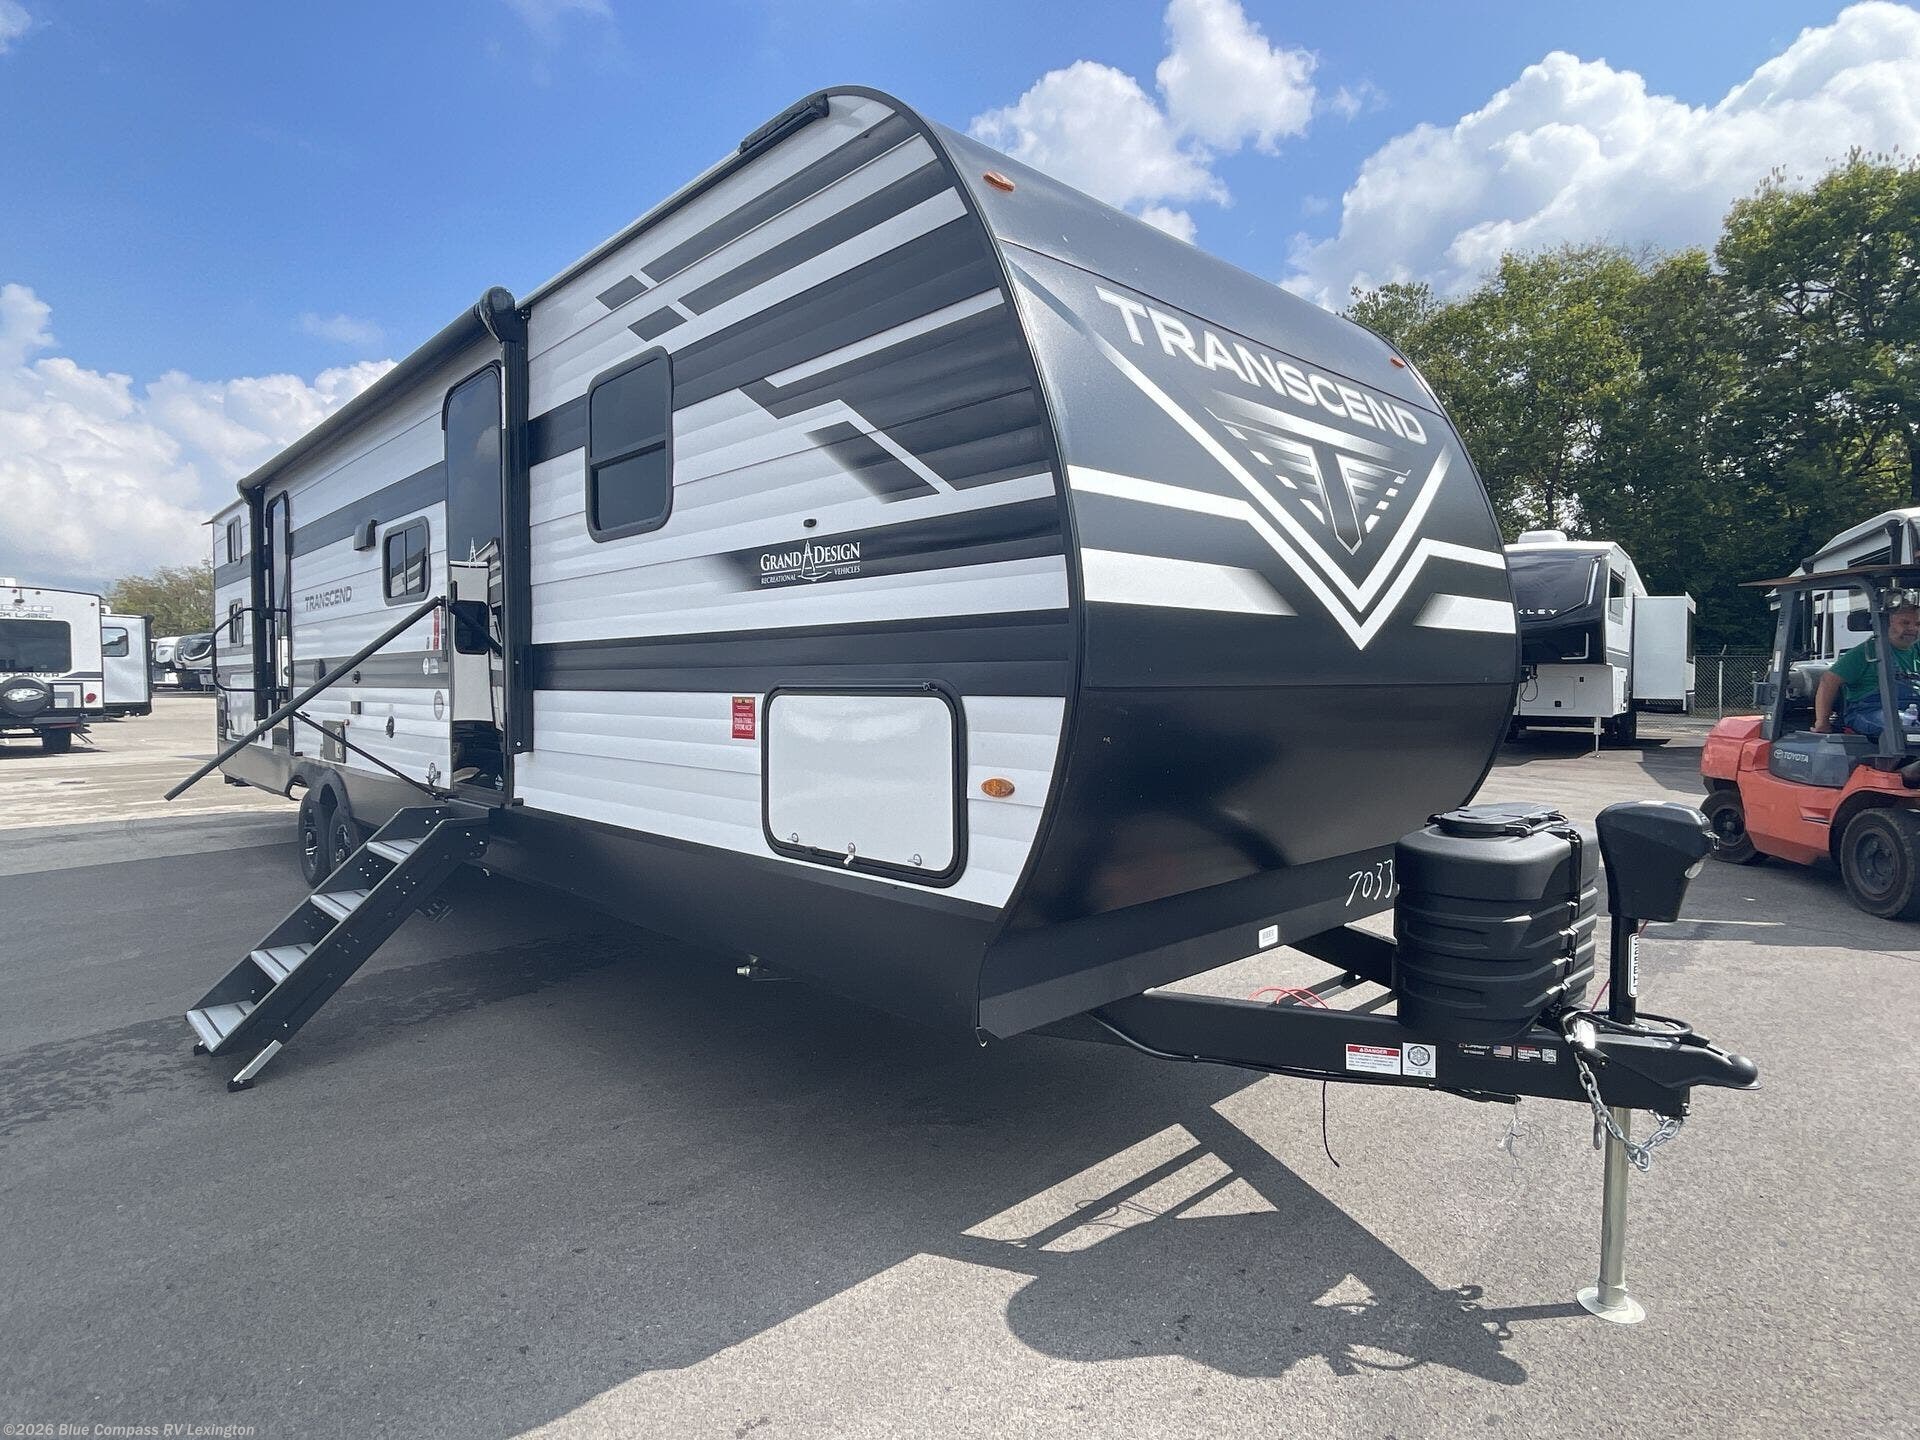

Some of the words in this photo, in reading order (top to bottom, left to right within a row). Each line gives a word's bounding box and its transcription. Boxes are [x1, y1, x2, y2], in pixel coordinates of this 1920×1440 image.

[1095, 285, 1428, 446] TRANSCEND
[760, 551, 802, 571] GRAND
[813, 542, 861, 564] DESIGN
[761, 573, 797, 585] RECREATIONAL
[834, 565, 861, 576] VEHICLES
[305, 585, 353, 612] TRANSCEND
[1783, 751, 1809, 763] TOYOTA
